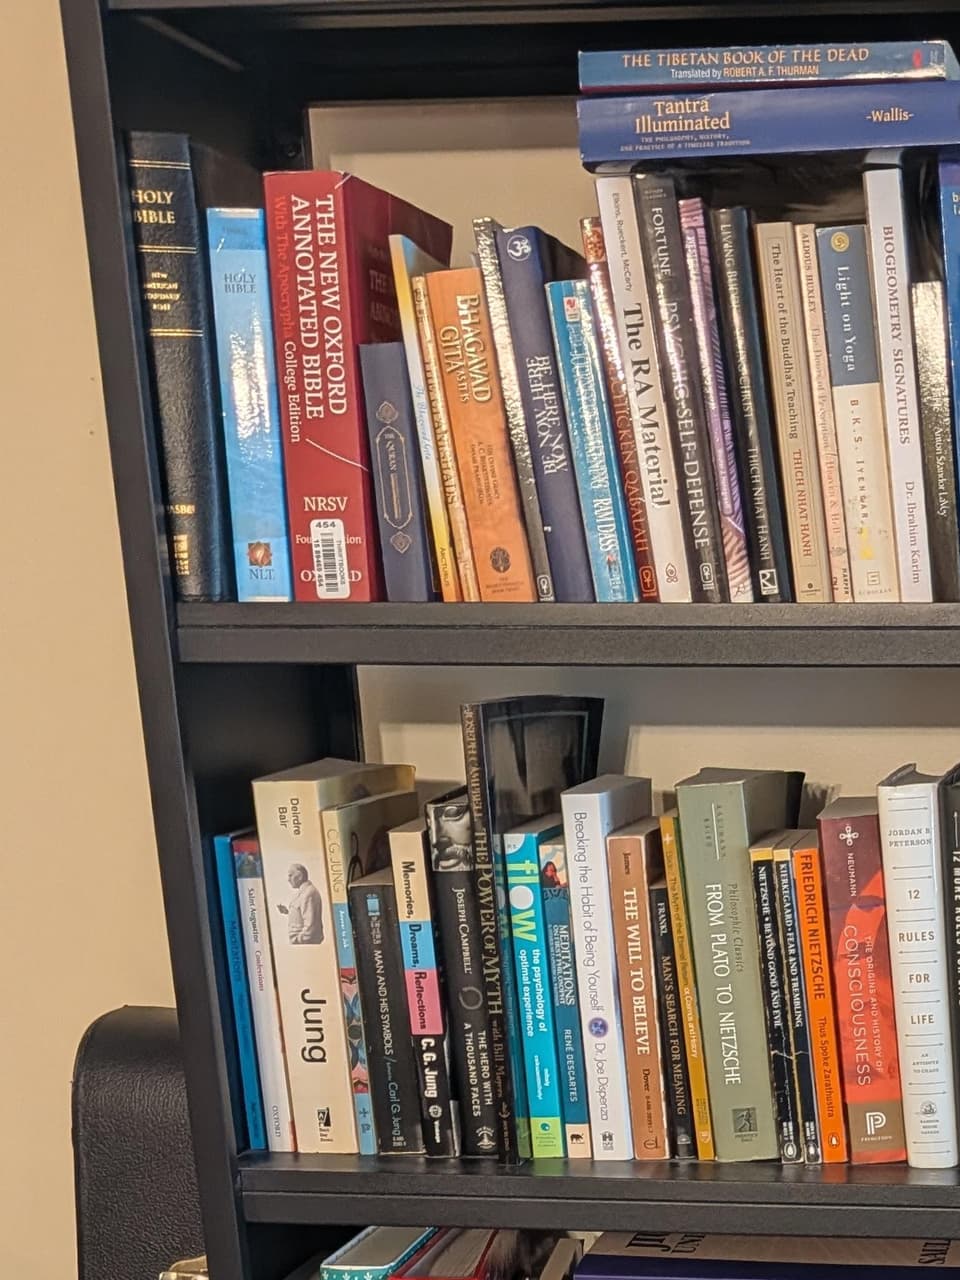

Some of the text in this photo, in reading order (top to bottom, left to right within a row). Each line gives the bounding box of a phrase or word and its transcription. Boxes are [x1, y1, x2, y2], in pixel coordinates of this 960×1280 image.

[622, 48, 870, 67] THE TIBETAN BOOK OF THE DEAD
[670, 65, 818, 79] Translated by ROBERT A. F. THURMAN
[635, 113, 731, 134] Illuminated
[654, 98, 709, 114] Tantra
[866, 109, 914, 123] -Wallis-
[224, 272, 257, 284] HOLY
[224, 283, 257, 294] BIBLE
[289, 194, 325, 419] ANNOTATED BIBLE
[314, 195, 347, 414] THE NEW OXFORD
[833, 266, 858, 371] Light on Yoga
[883, 226, 909, 445] BIOGEOMETRY SIGNATURES
[621, 302, 672, 508] The RA Material
[303, 496, 348, 512] NRSV
[402, 861, 416, 918] Memories,
[906, 888, 920, 900] 12
[408, 924, 422, 967] Dreams,
[801, 855, 824, 1000] FRIEDRICH NIETZSCHE
[898, 930, 935, 943] RULES
[623, 889, 649, 1055] THE WILL TO BELIEVE
[705, 884, 740, 1085] FROM PLATO TO NIETZSCHE
[908, 973, 930, 985] FOR
[414, 972, 428, 1029] Reflections
[843, 926, 870, 1086] CONSCIOUSNESS
[909, 1013, 934, 1025] LIFE
[299, 988, 327, 1062] Jung
[463, 1033, 477, 1084] THOUSAND
[477, 1031, 492, 1105] THE HERO WITH
[469, 1087, 481, 1116] FACES
